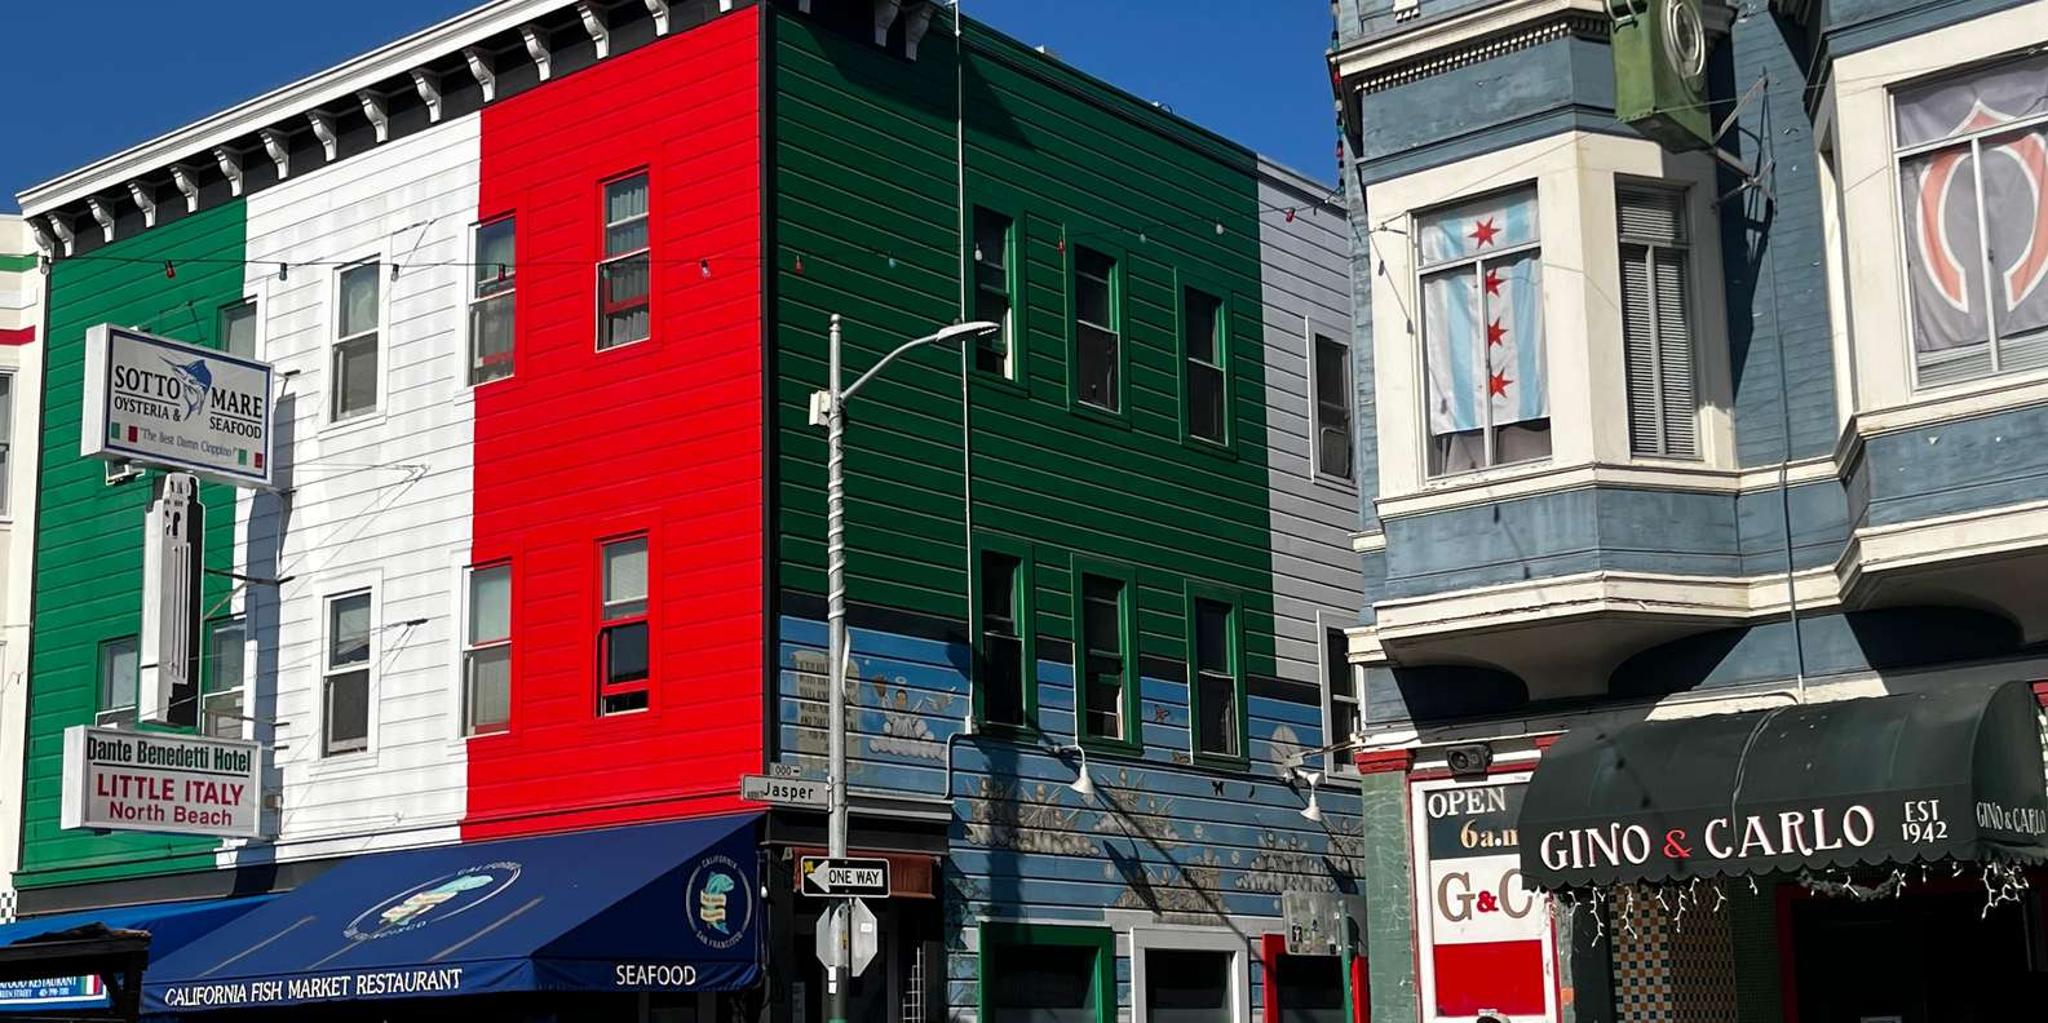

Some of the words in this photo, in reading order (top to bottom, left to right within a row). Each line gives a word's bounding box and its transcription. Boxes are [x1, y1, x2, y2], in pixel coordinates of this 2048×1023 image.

[114, 364, 180, 400] SOTTO
[211, 387, 263, 419] MARE
[114, 395, 170, 420] OYSTERIA
[172, 409, 181, 421] &
[209, 417, 262, 439] SEAFOOD
[159, 432, 175, 445] Best
[176, 436, 199, 450] Damn
[87, 737, 132, 762] Dante
[137, 740, 210, 770] Benedetti
[214, 748, 251, 772] Hotel
[97, 773, 175, 801] LITTLE
[185, 780, 244, 806] ITALY
[763, 782, 814, 801] Jasper
[109, 801, 165, 822] North
[174, 806, 232, 826] Beach
[1427, 787, 1507, 820] OPEN
[1904, 799, 1941, 822] EST
[1976, 801, 2004, 830] GINO
[2004, 811, 2013, 830] &
[2012, 807, 2047, 836] CARLO
[1540, 822, 1651, 872] GINO
[1663, 828, 1693, 860] &
[1704, 805, 1876, 860] CARLO
[1902, 821, 1948, 844] 1942
[829, 869, 852, 884] ONE
[856, 869, 880, 884] WAY
[164, 984, 247, 1007] CALIFORNIA
[251, 981, 283, 1002] FISH
[287, 976, 352, 999] MARKET
[357, 968, 463, 996] RESTAURANT
[615, 964, 697, 987] SEAFOOD
